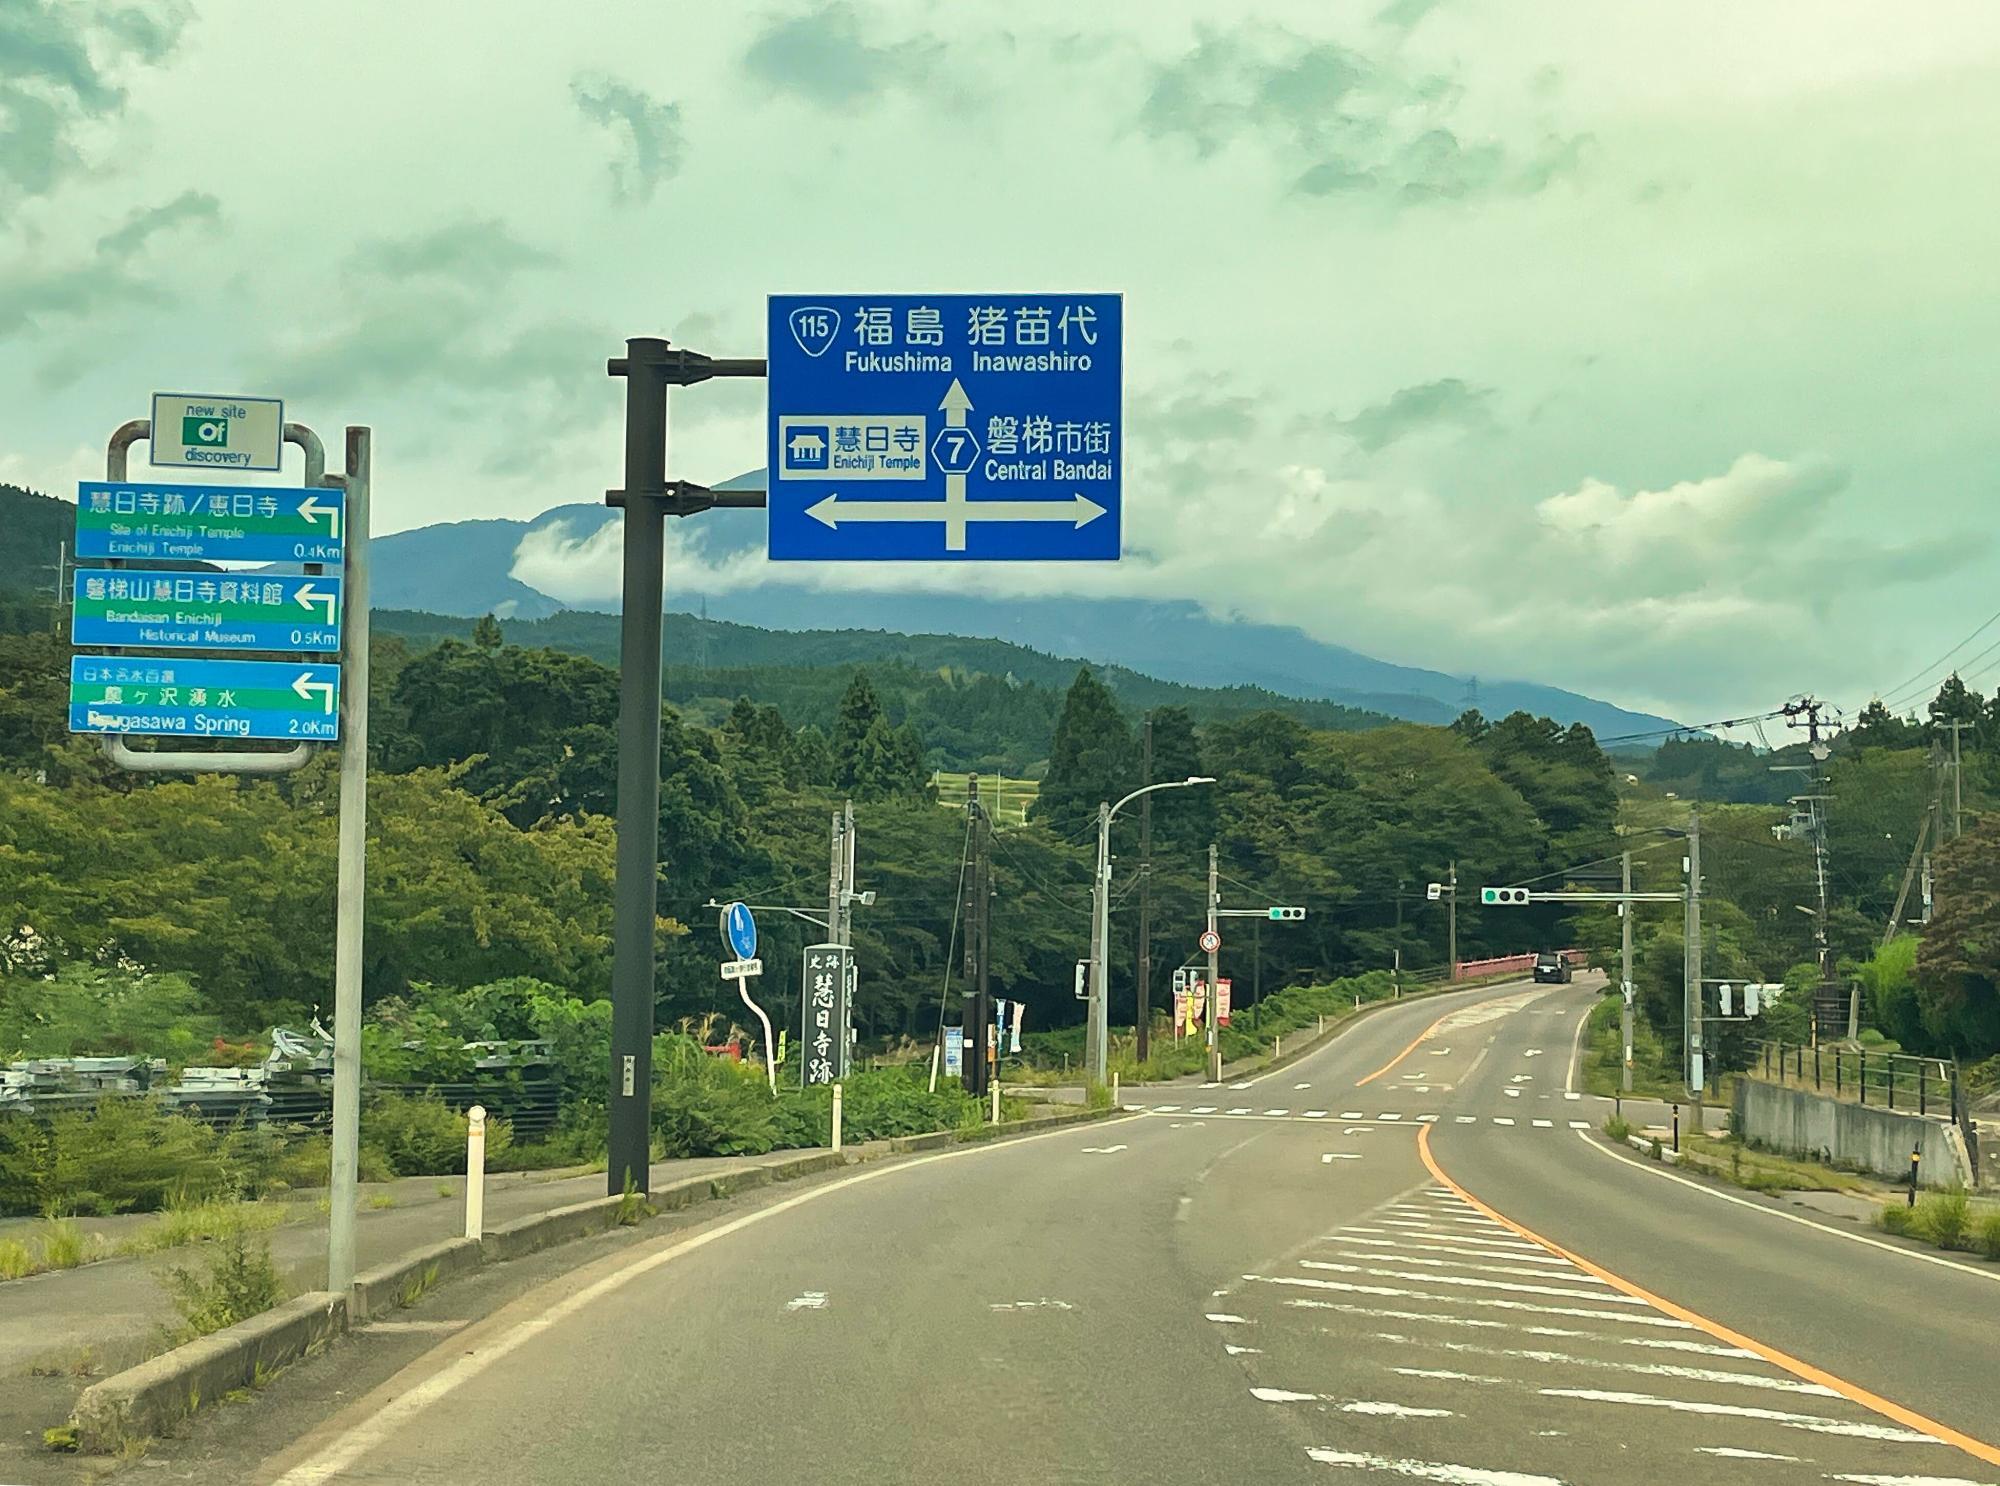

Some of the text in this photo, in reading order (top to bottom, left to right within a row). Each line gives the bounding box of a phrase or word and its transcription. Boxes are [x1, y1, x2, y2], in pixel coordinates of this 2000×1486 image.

[799, 315, 829, 338] 115
[853, 306, 1098, 346] 福島 猪苗代
[845, 350, 1091, 372] Fukushima Inawashiro
[186, 404, 246, 418] new site
[198, 422, 225, 442] of
[835, 426, 920, 452] 慧日寺
[987, 415, 1111, 454] 磐梯市街
[185, 447, 251, 466] discovery
[947, 438, 965, 463] 7
[834, 455, 920, 472] Enichiji Temple
[985, 460, 1112, 480] Central Bandai
[110, 523, 131, 536] Site
[136, 524, 148, 536] of
[199, 525, 245, 540] Temple
[162, 542, 204, 558] Temple
[140, 628, 256, 643] Historical Museum
[194, 713, 251, 736] Spring
